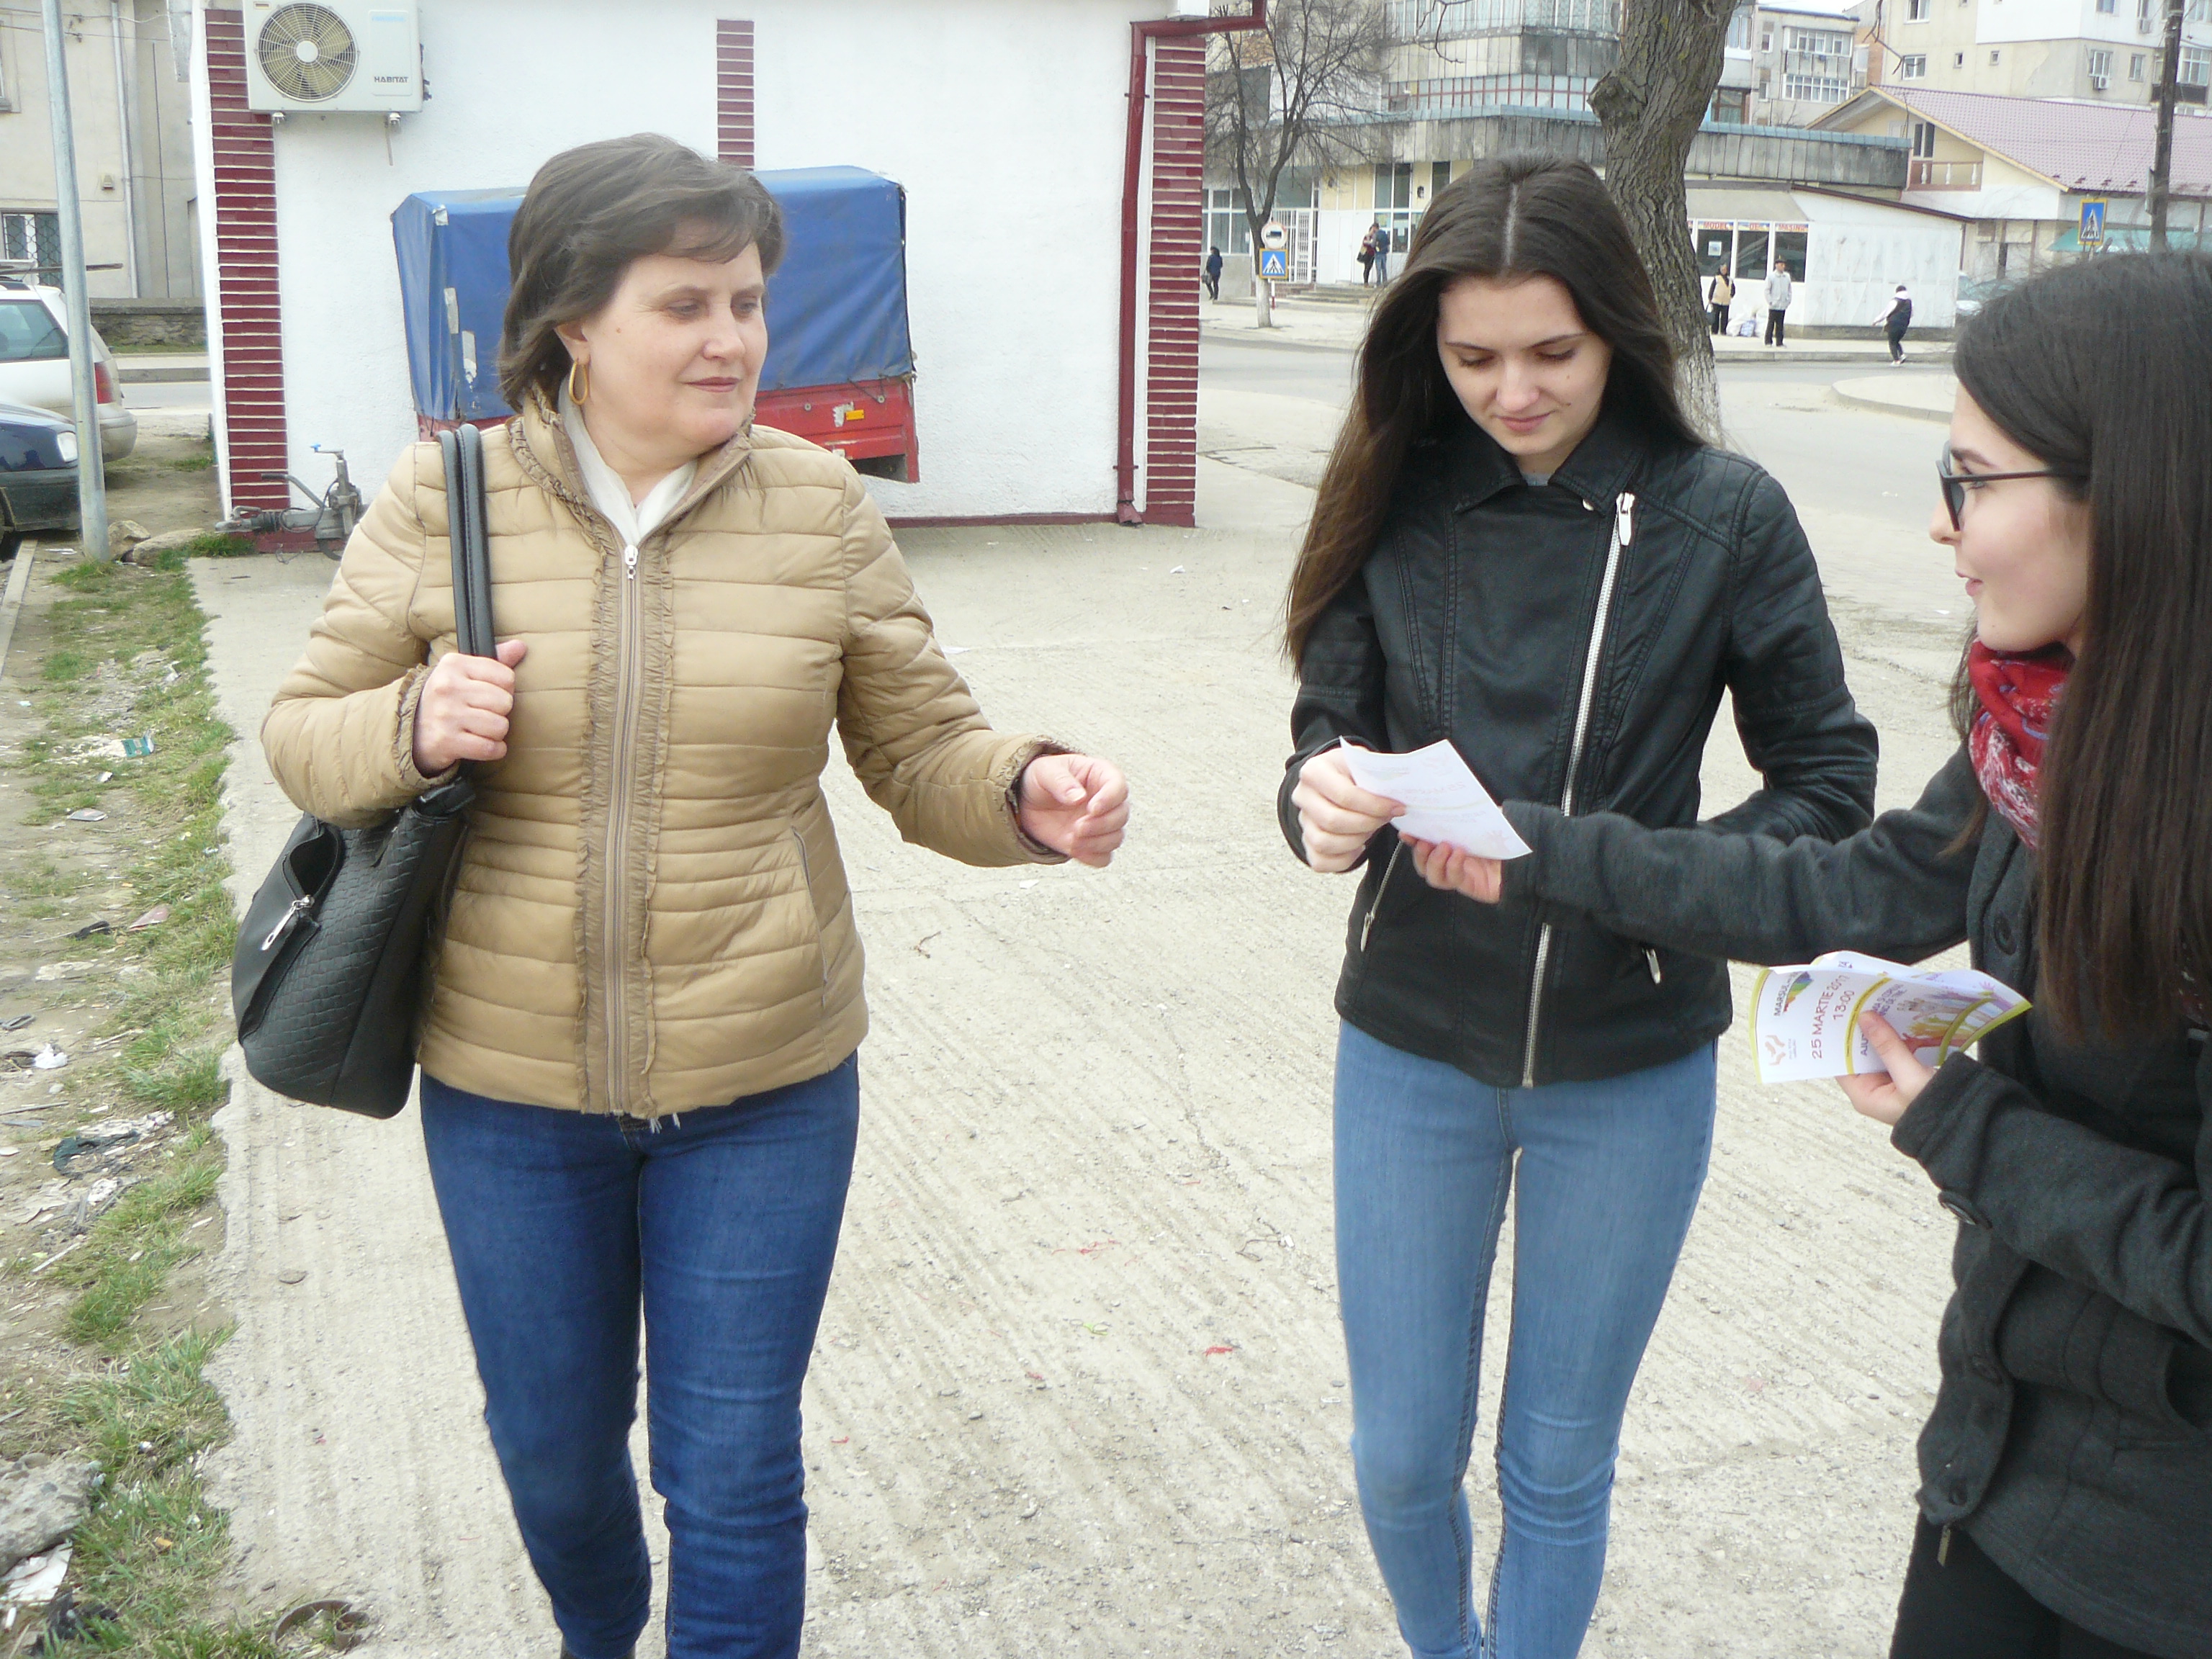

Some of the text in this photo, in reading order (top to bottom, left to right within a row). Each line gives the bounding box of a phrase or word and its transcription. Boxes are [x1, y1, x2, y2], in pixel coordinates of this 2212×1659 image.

[1812, 991, 1834, 1035] MARTIE
[1833, 989, 1855, 1020] 13:00
[1811, 1038, 1822, 1059] 25
